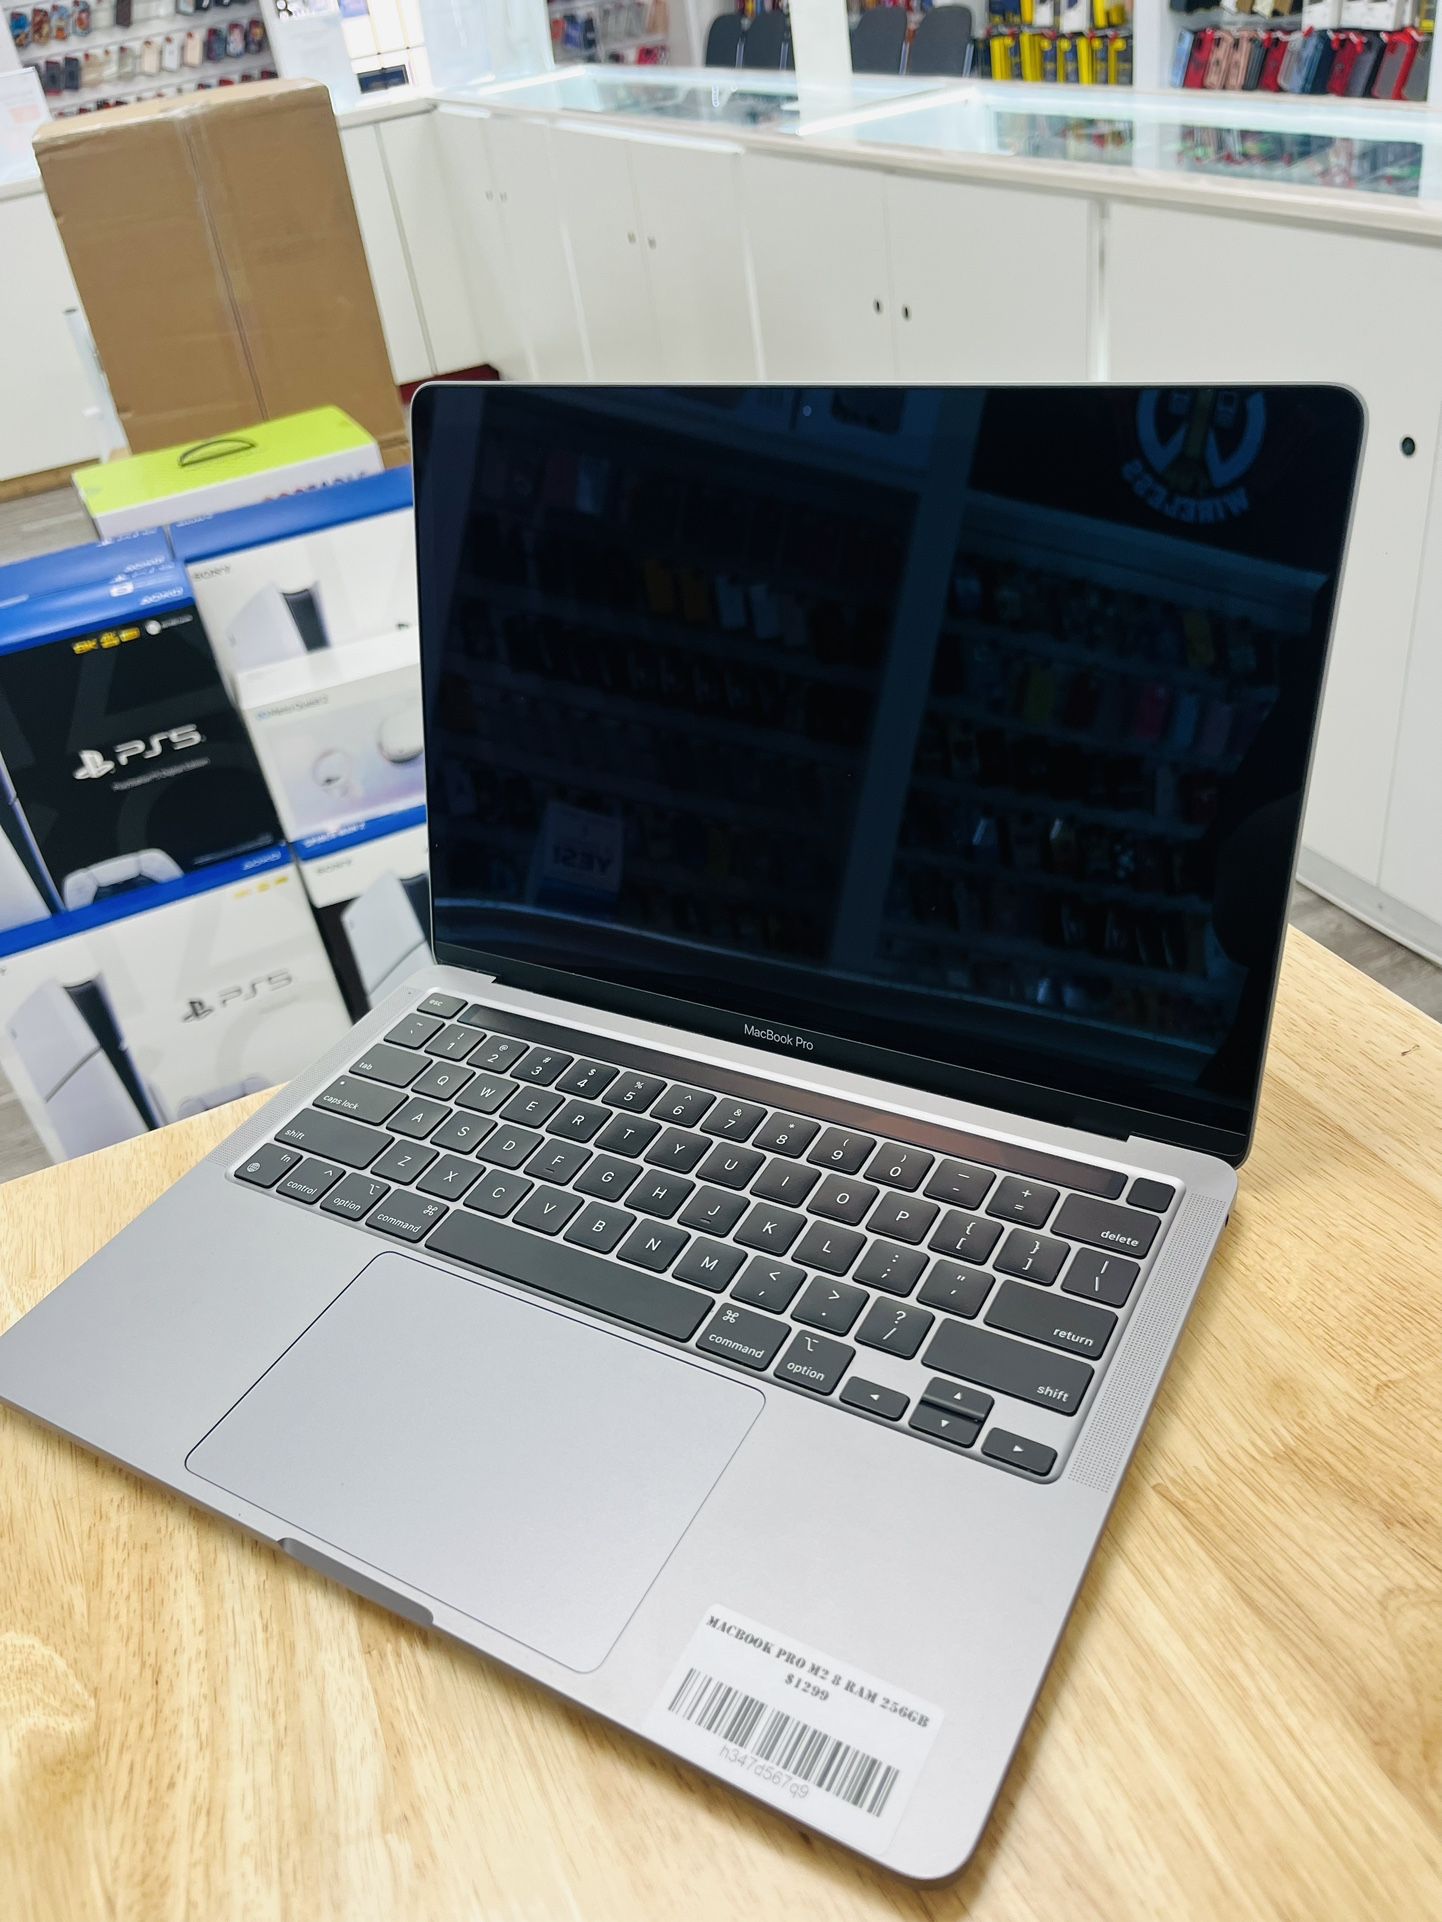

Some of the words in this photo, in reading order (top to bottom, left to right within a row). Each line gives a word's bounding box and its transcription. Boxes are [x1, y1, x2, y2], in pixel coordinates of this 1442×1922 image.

[113, 723, 202, 765] PS5
[218, 968, 292, 1007] PS5
[428, 999, 444, 1008] esc
[744, 1024, 793, 1045] MacBook
[796, 1036, 813, 1050] Pro
[486, 1053, 500, 1064] 2
[358, 1061, 373, 1071] tab
[530, 1065, 543, 1076] 3
[436, 1075, 450, 1087] Q
[576, 1078, 589, 1088] 4
[479, 1086, 497, 1098] W
[623, 1090, 637, 1102] 5
[322, 1093, 342, 1105] caps
[342, 1099, 358, 1110] lock
[525, 1100, 539, 1112] E
[672, 1105, 685, 1116] 6
[410, 1112, 424, 1123] A
[571, 1114, 585, 1126] R
[723, 1118, 737, 1129] 7
[285, 1130, 305, 1140] shift
[456, 1126, 471, 1137] S
[623, 1128, 636, 1140] T
[502, 1139, 516, 1151] D
[775, 1134, 789, 1145] 8
[673, 1143, 686, 1155] Y
[830, 1149, 844, 1161] 9
[281, 1154, 291, 1162] fn
[396, 1155, 413, 1167] Z
[551, 1154, 565, 1165] F
[724, 1158, 739, 1171] U
[442, 1170, 459, 1183] X
[601, 1171, 615, 1183] G
[287, 1181, 317, 1195] control
[491, 1186, 506, 1199] C
[651, 1186, 668, 1200] H
[333, 1198, 361, 1211] option
[543, 1202, 557, 1215] V
[707, 1205, 721, 1216] J
[895, 1210, 910, 1222] P
[377, 1214, 421, 1233] command
[591, 1219, 607, 1233] B
[762, 1220, 778, 1235] K
[644, 1237, 662, 1252] N
[1101, 1231, 1139, 1246] delete
[821, 1240, 832, 1254] L
[700, 1255, 719, 1271] M
[1053, 1329, 1093, 1346] return
[707, 1332, 765, 1360] command
[787, 1362, 824, 1381] option
[1037, 1386, 1068, 1402] shift
[705, 1614, 776, 1655] MACBOOK
[775, 1647, 807, 1670] PRO
[807, 1662, 830, 1681] M2
[831, 1674, 842, 1687] 8
[844, 1679, 878, 1704] RAM
[880, 1697, 931, 1728] 256GB
[784, 1673, 830, 1702] $1299
